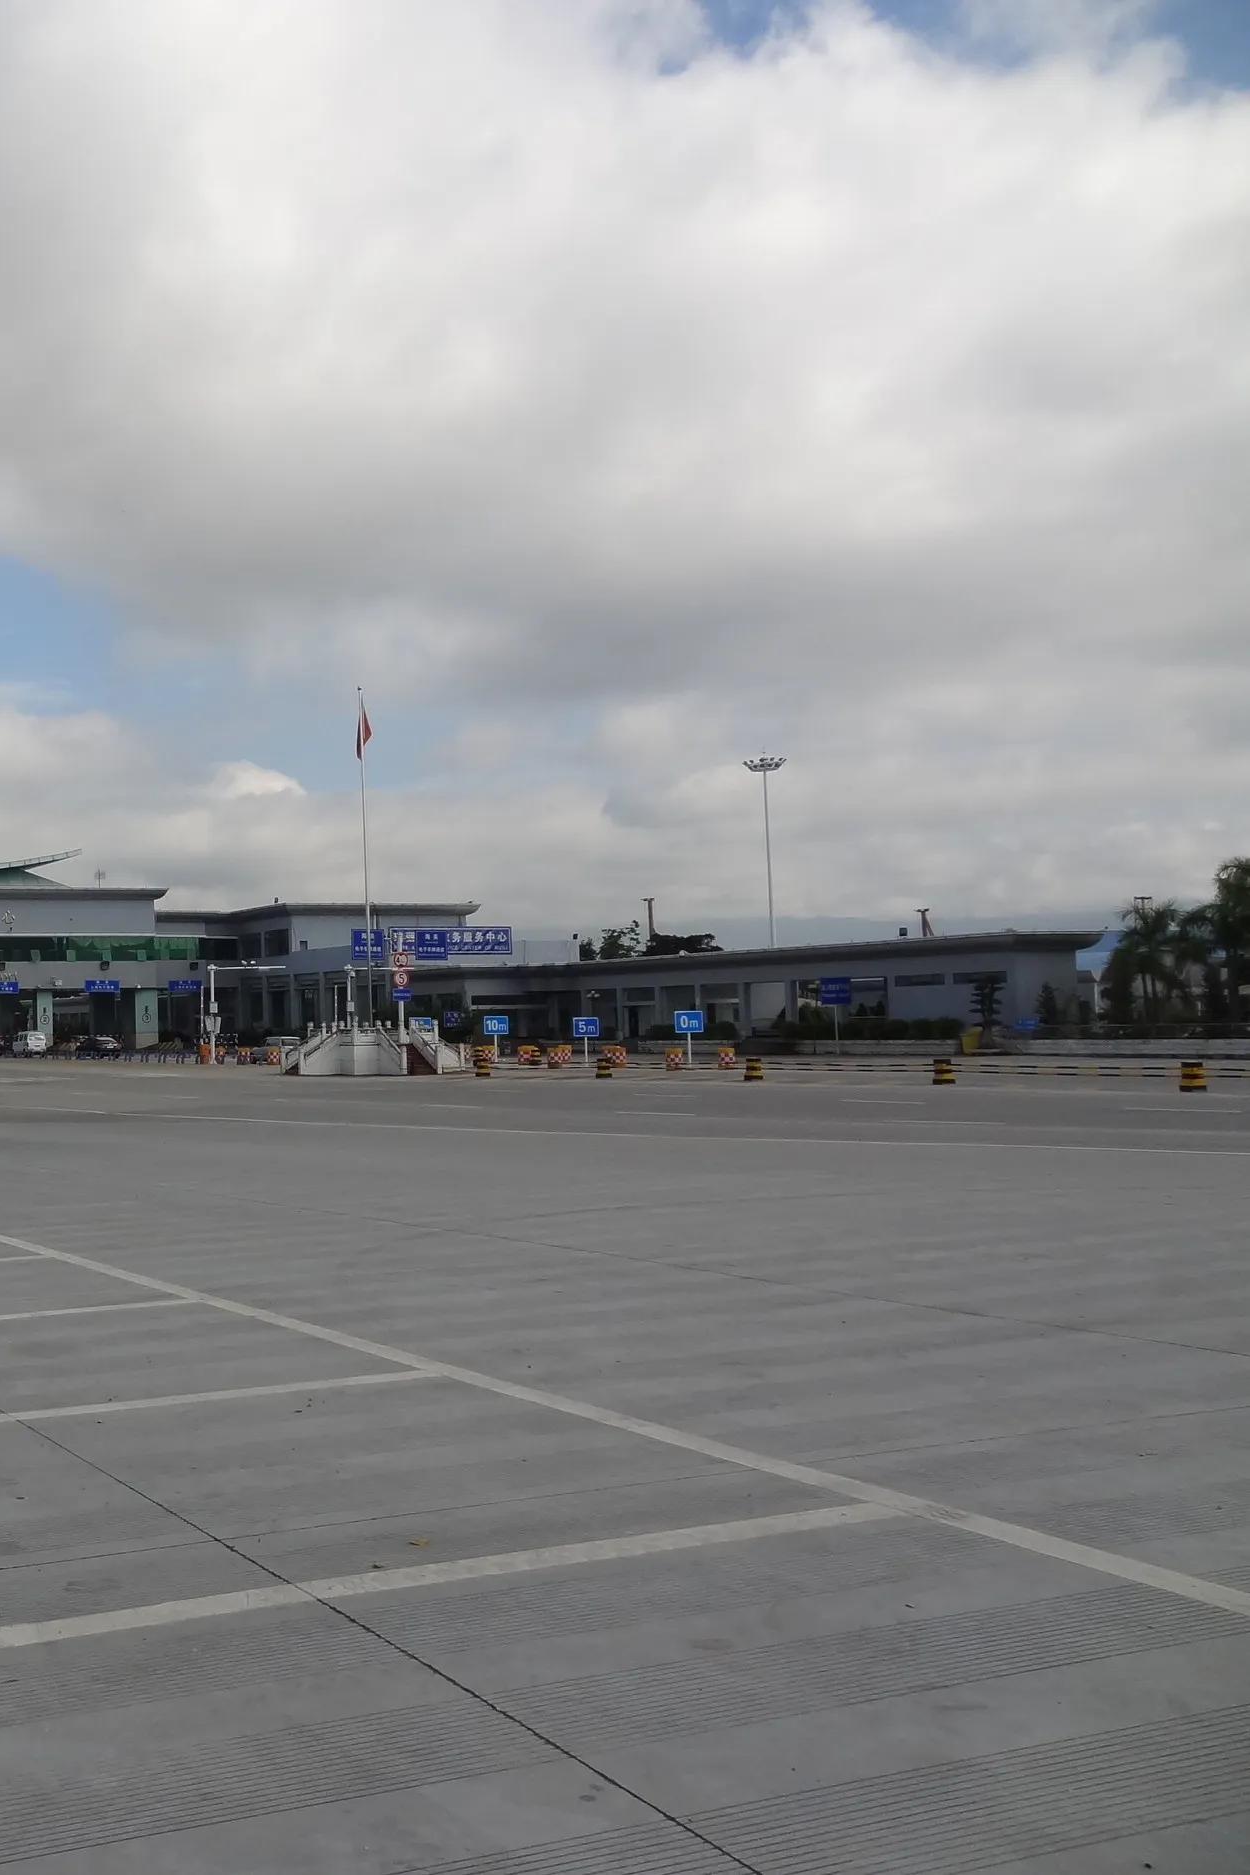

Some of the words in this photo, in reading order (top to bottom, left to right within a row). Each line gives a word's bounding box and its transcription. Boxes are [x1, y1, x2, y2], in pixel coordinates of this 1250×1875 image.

[398, 973, 405, 984] 5
[486, 1020, 507, 1032] 10m
[578, 1021, 596, 1033] 5m
[680, 1015, 699, 1028] 0m
